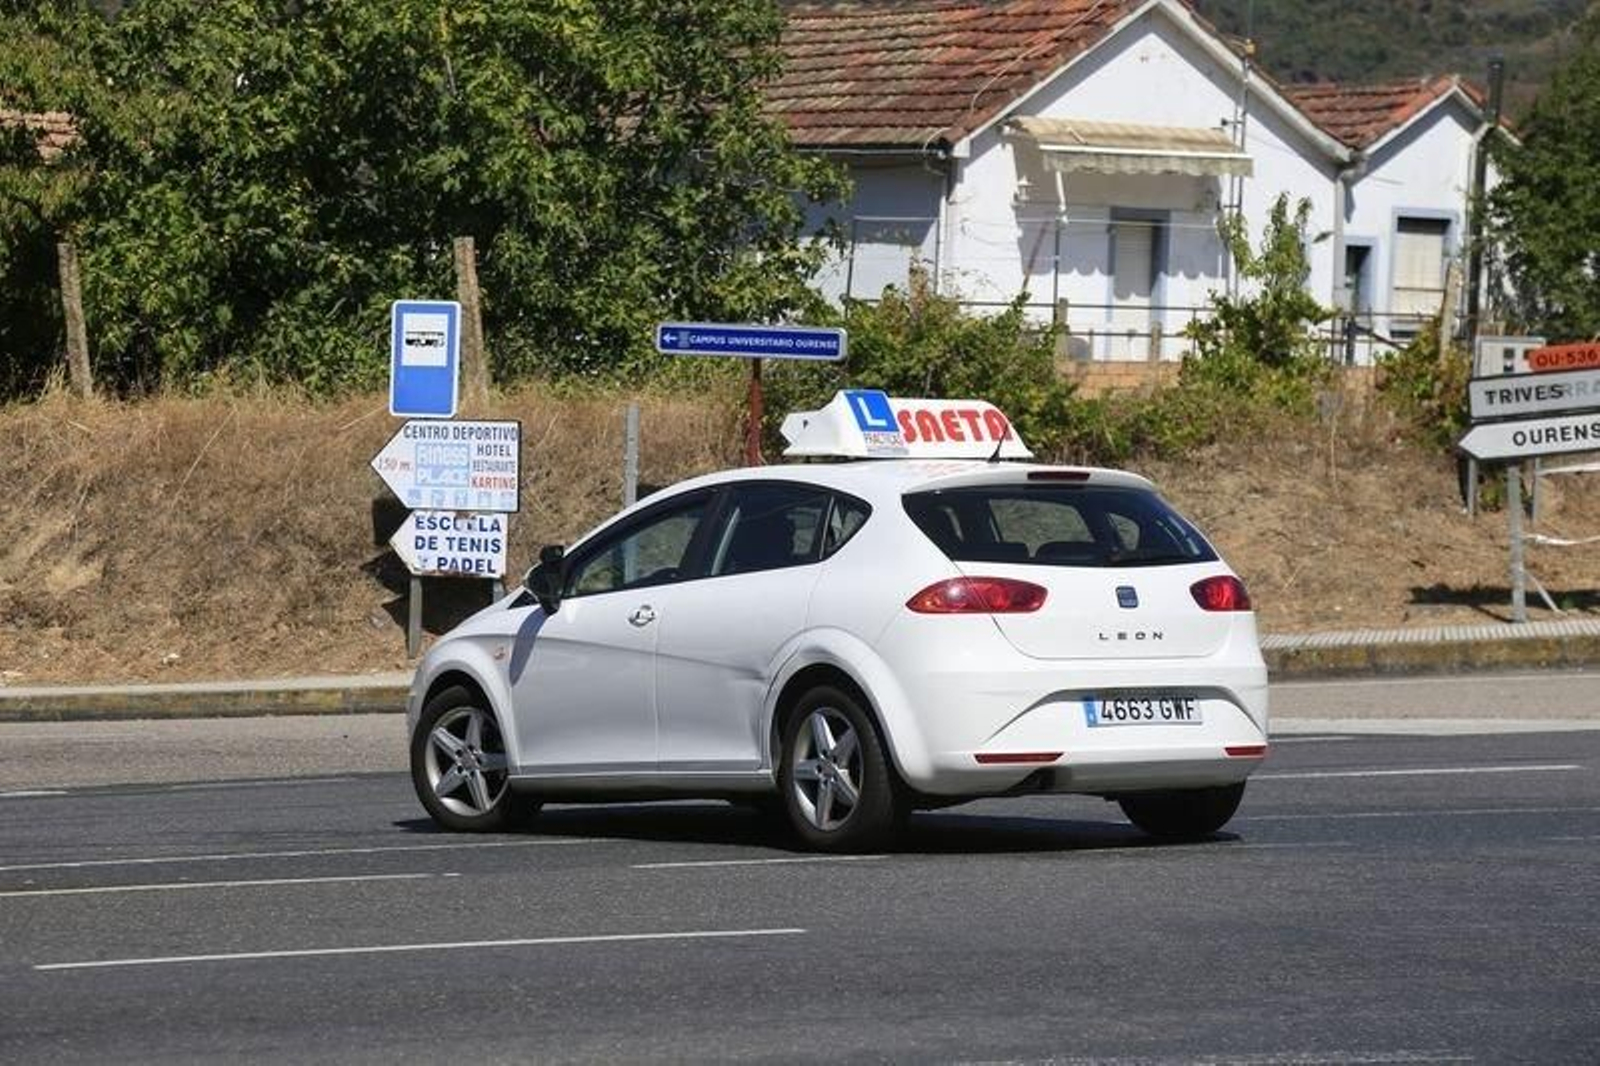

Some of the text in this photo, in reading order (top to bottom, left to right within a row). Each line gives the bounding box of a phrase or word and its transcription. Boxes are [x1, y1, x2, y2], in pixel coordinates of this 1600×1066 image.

[690, 335, 838, 349] CAMPUS UNIVERSITARIO OURENSE
[1485, 384, 1564, 405] TRIVES
[857, 397, 888, 426] L
[403, 425, 518, 442] CENTRO DEPORTIVO
[897, 409, 1013, 443] SAETA
[1512, 422, 1600, 447] OURENS
[477, 444, 512, 456] HOTEL
[473, 460, 516, 474] RESTAURANTE
[471, 477, 516, 490] KARTING
[415, 535, 501, 553] DE TENIS
[437, 557, 496, 573] PADEL
[1098, 632, 1164, 640] LEON
[1101, 698, 1154, 720] 4663
[1158, 697, 1195, 720] GWF
